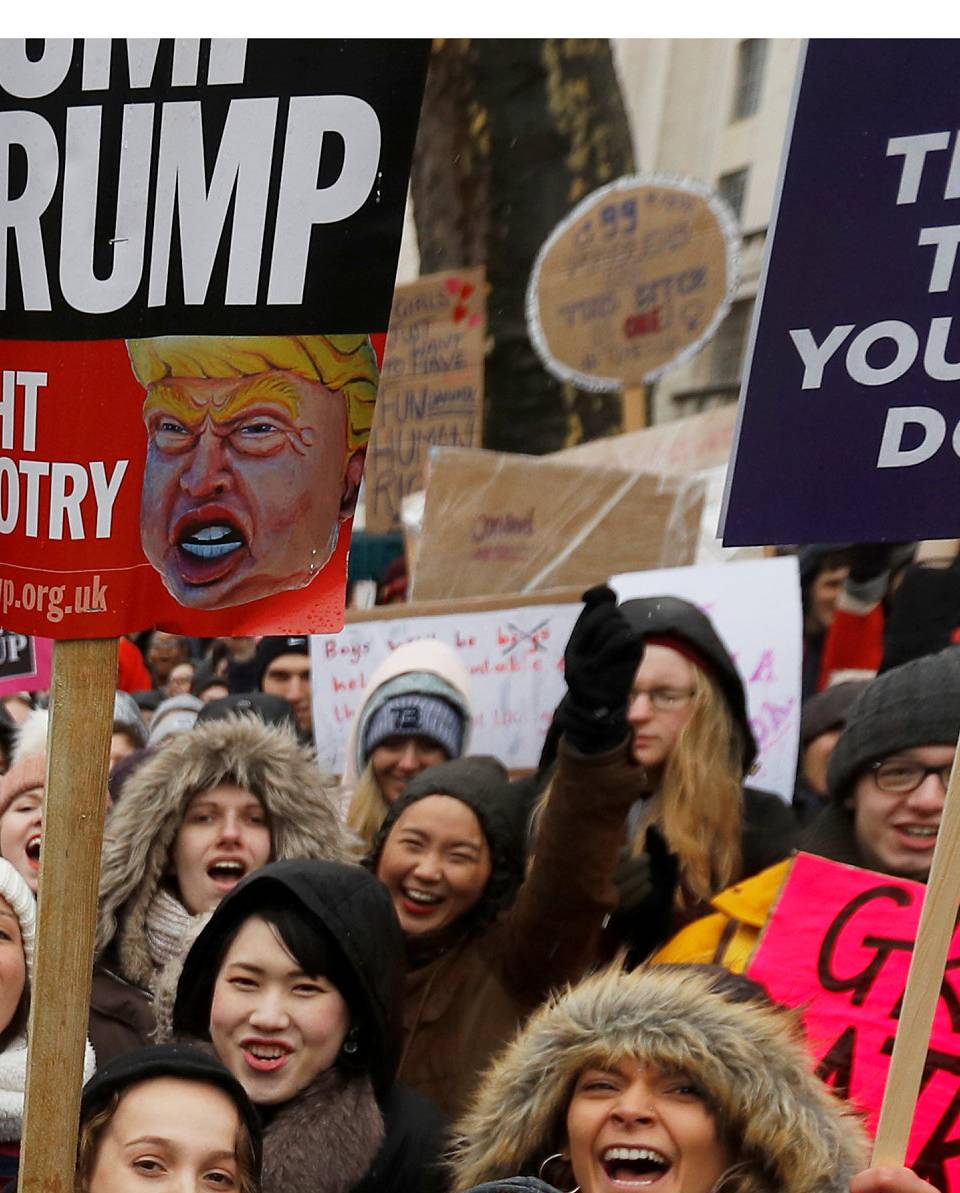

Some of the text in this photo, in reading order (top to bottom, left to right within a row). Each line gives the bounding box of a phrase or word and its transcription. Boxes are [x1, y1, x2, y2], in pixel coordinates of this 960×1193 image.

[885, 128, 960, 206] T
[876, 404, 960, 470] D
[324, 638, 371, 664] Boys
[332, 671, 368, 693] hel
